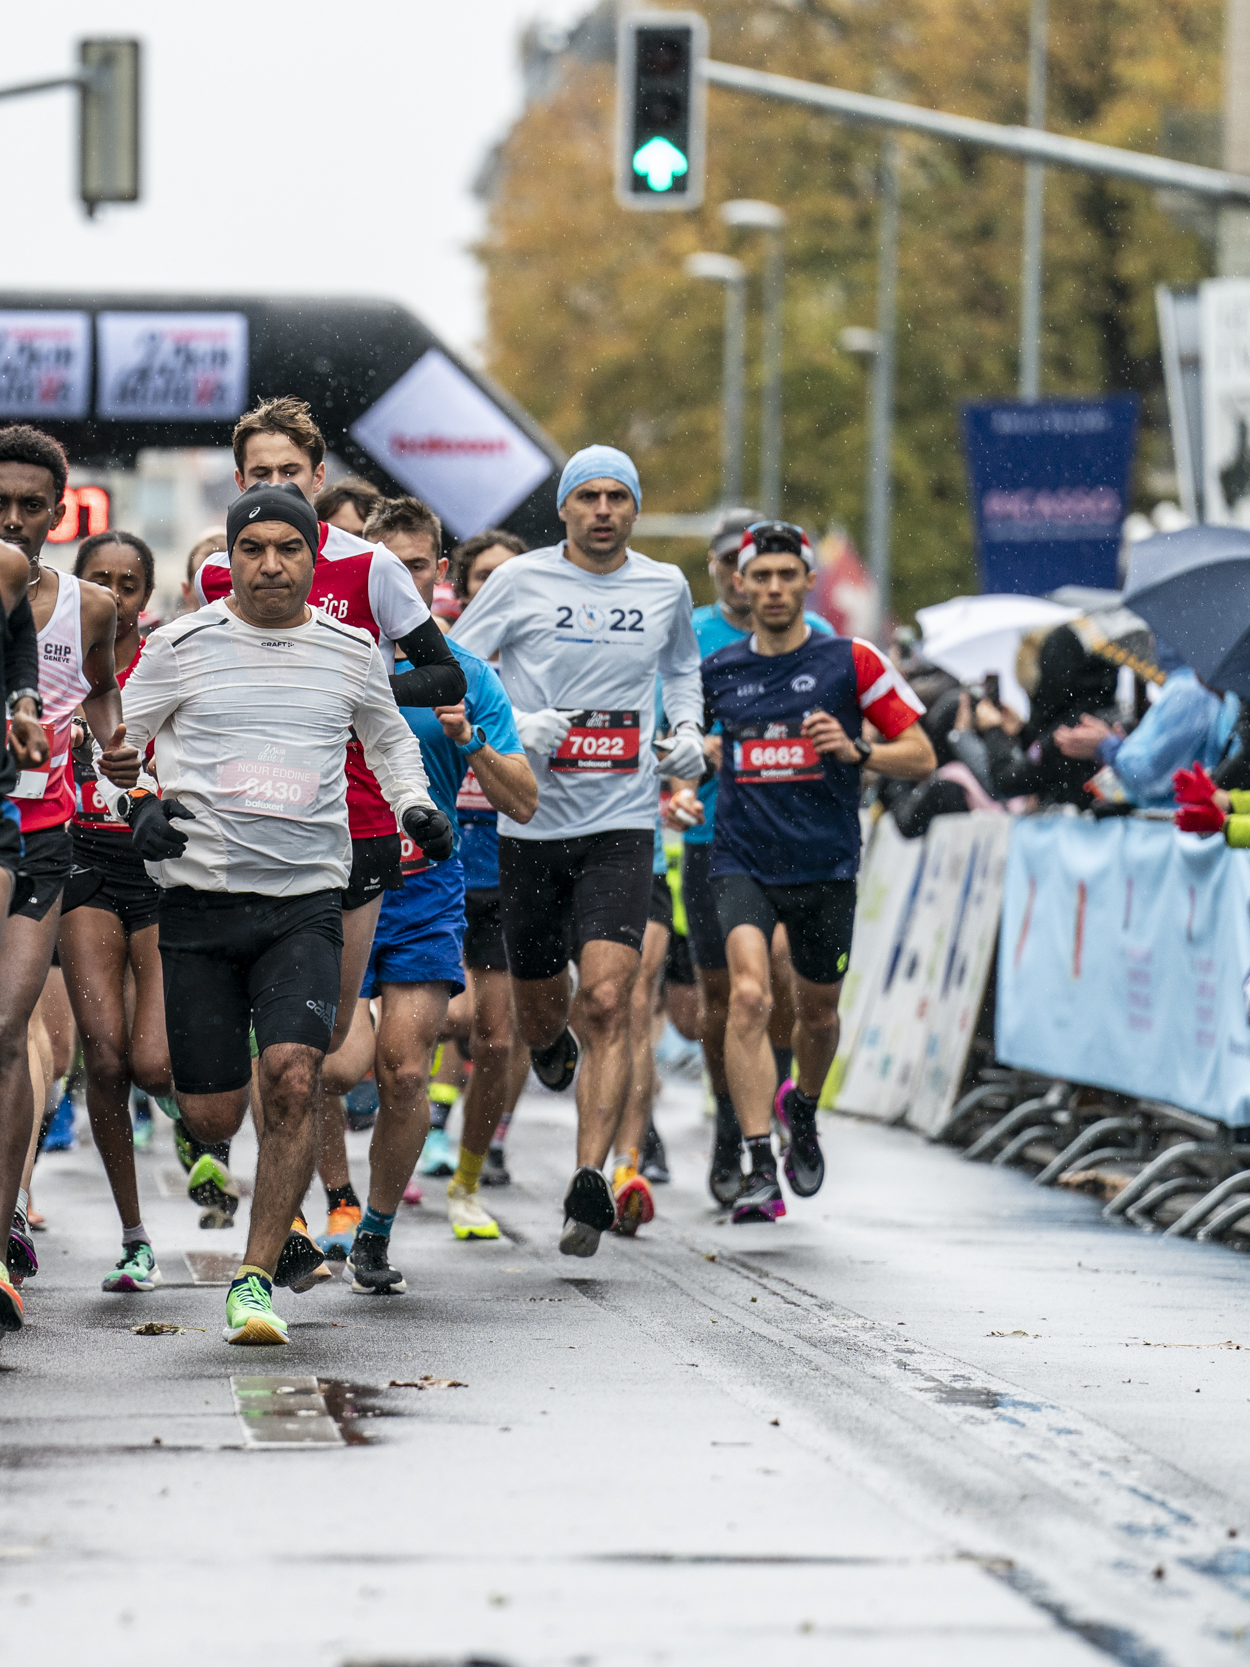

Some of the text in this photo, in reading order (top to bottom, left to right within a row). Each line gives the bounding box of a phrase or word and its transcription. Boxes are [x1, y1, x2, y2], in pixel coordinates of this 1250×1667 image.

[44, 643, 71, 657] CHP
[569, 736, 624, 755] 7022
[750, 746, 805, 766] 6662
[237, 763, 270, 776] NOUR
[272, 767, 310, 783] EDDINE
[244, 777, 302, 802] 6430
[245, 799, 284, 812] balexert
